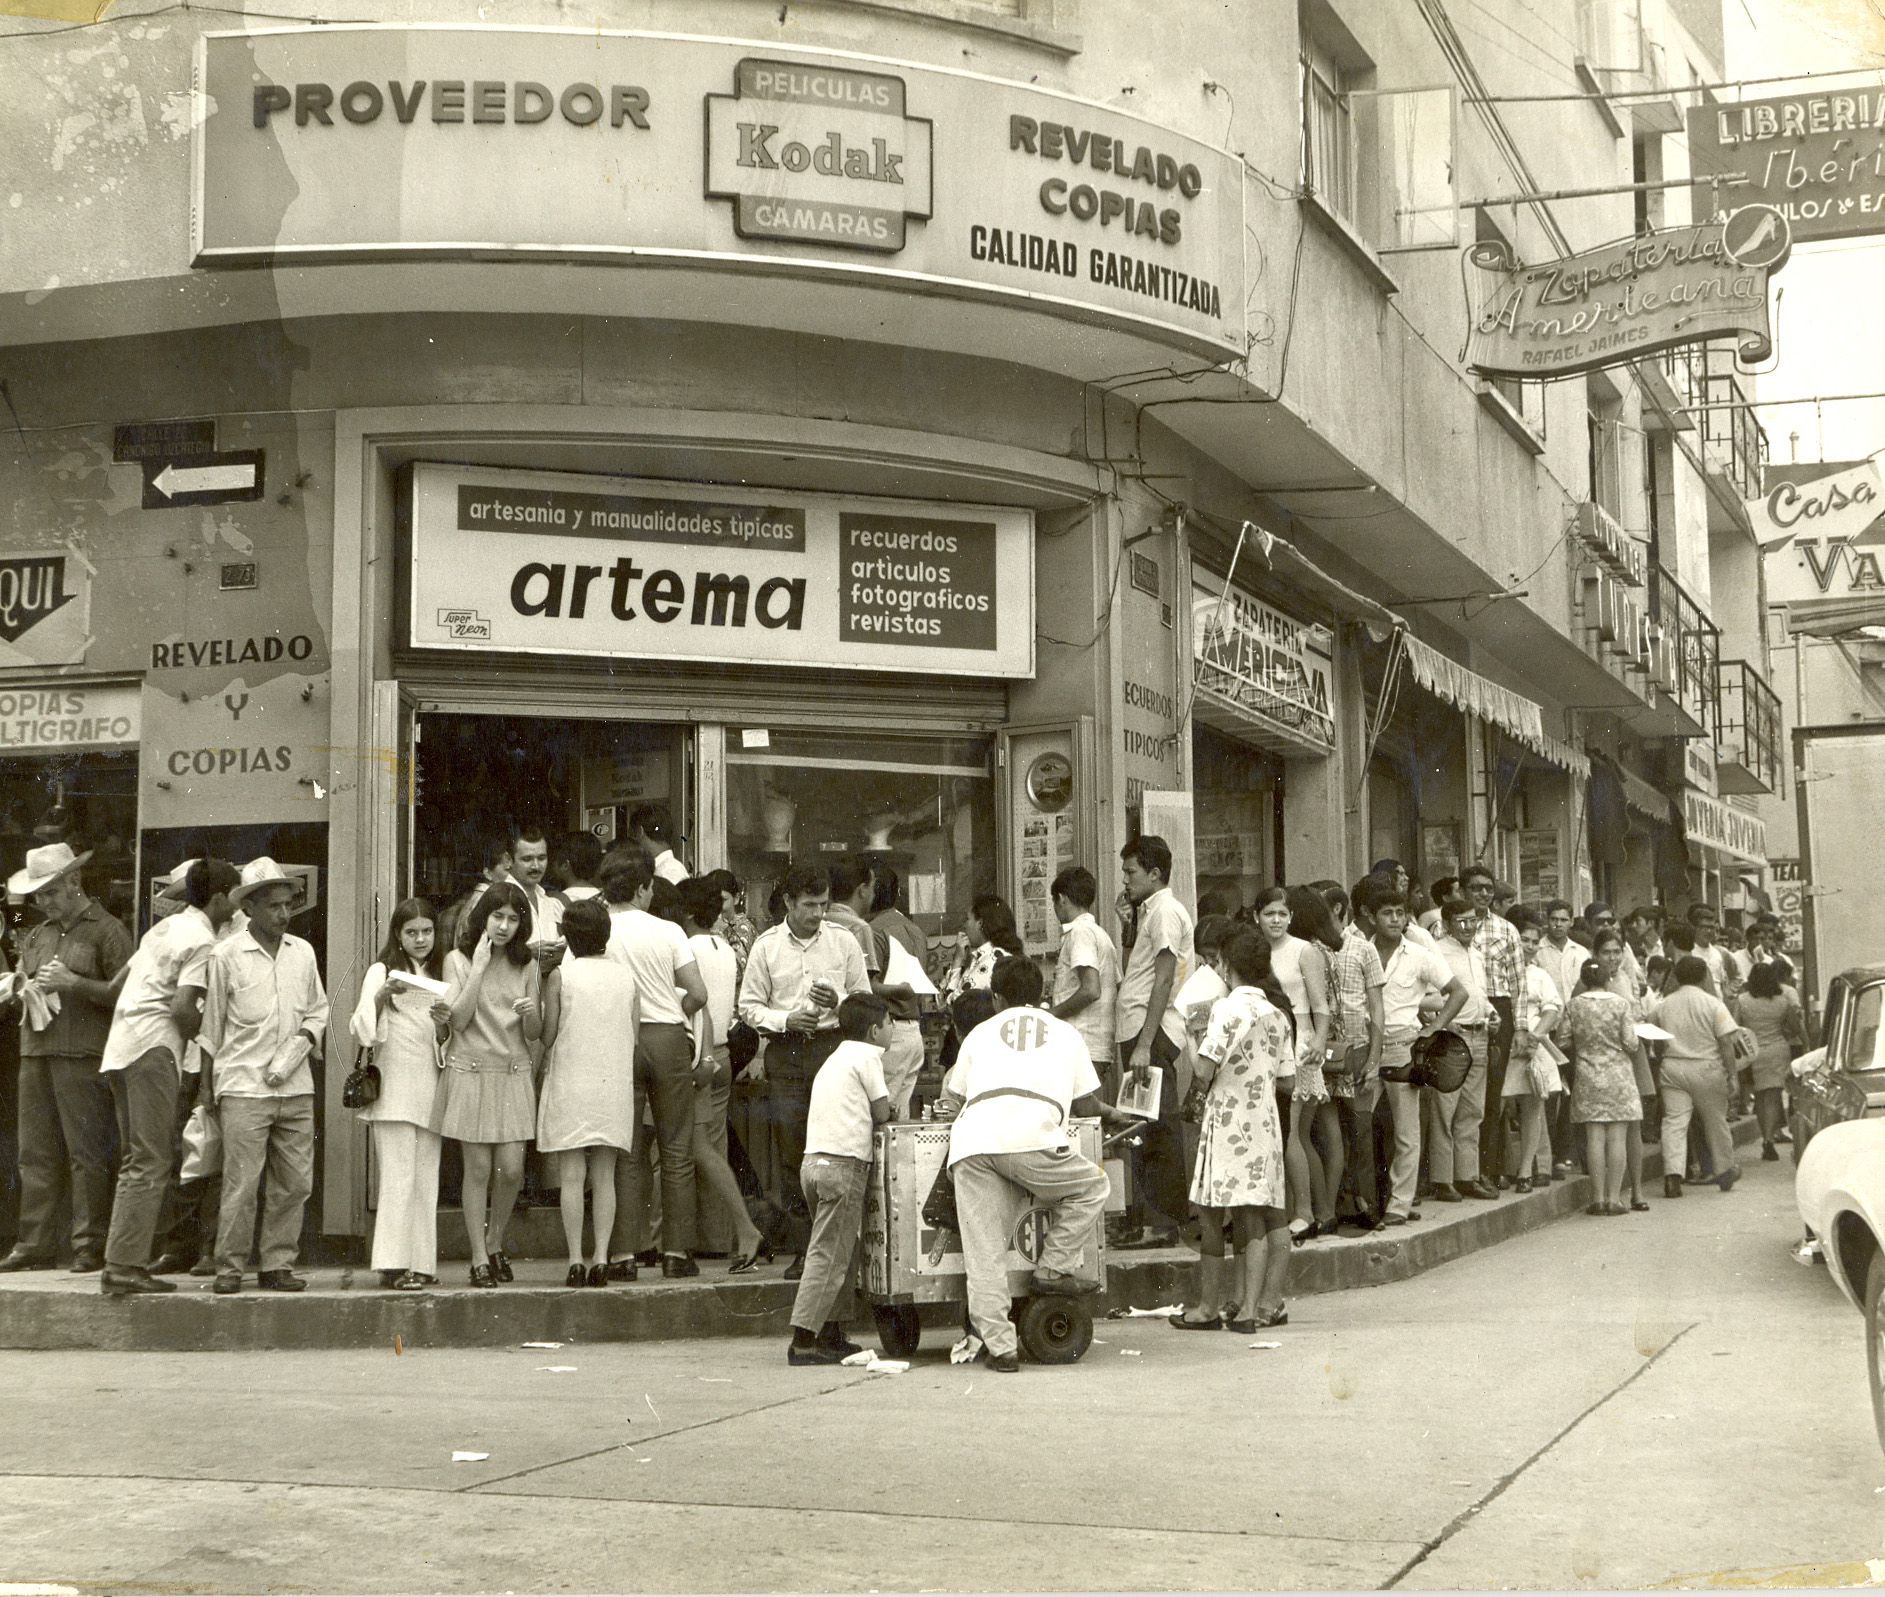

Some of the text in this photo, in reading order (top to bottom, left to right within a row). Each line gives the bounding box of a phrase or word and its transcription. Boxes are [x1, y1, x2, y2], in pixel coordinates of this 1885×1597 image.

[252, 80, 651, 130] PROVEEDOR
[754, 69, 890, 106] PELICULAS
[735, 122, 905, 184] Kodak
[1009, 114, 1203, 199] REVELADO
[754, 205, 888, 240] CAMARAS
[1039, 178, 1182, 244] COPIAS
[970, 225, 1222, 320] CALIDAD GARANTIZADA
[1522, 325, 1650, 366] RAFAEL JAIMES
[573, 509, 584, 530] y
[591, 510, 723, 536] manualidades
[1767, 481, 1877, 528] Casa
[850, 528, 958, 553] recuerdos
[510, 557, 807, 631] artema
[850, 583, 989, 612] fotograficos
[850, 611, 942, 635] revistas
[152, 635, 313, 668] REVELADO
[225, 693, 249, 720] Y
[167, 745, 292, 776] COPIAS
[1123, 728, 1165, 762] TIPICOS
[1000, 1015, 1049, 1051] EFE
